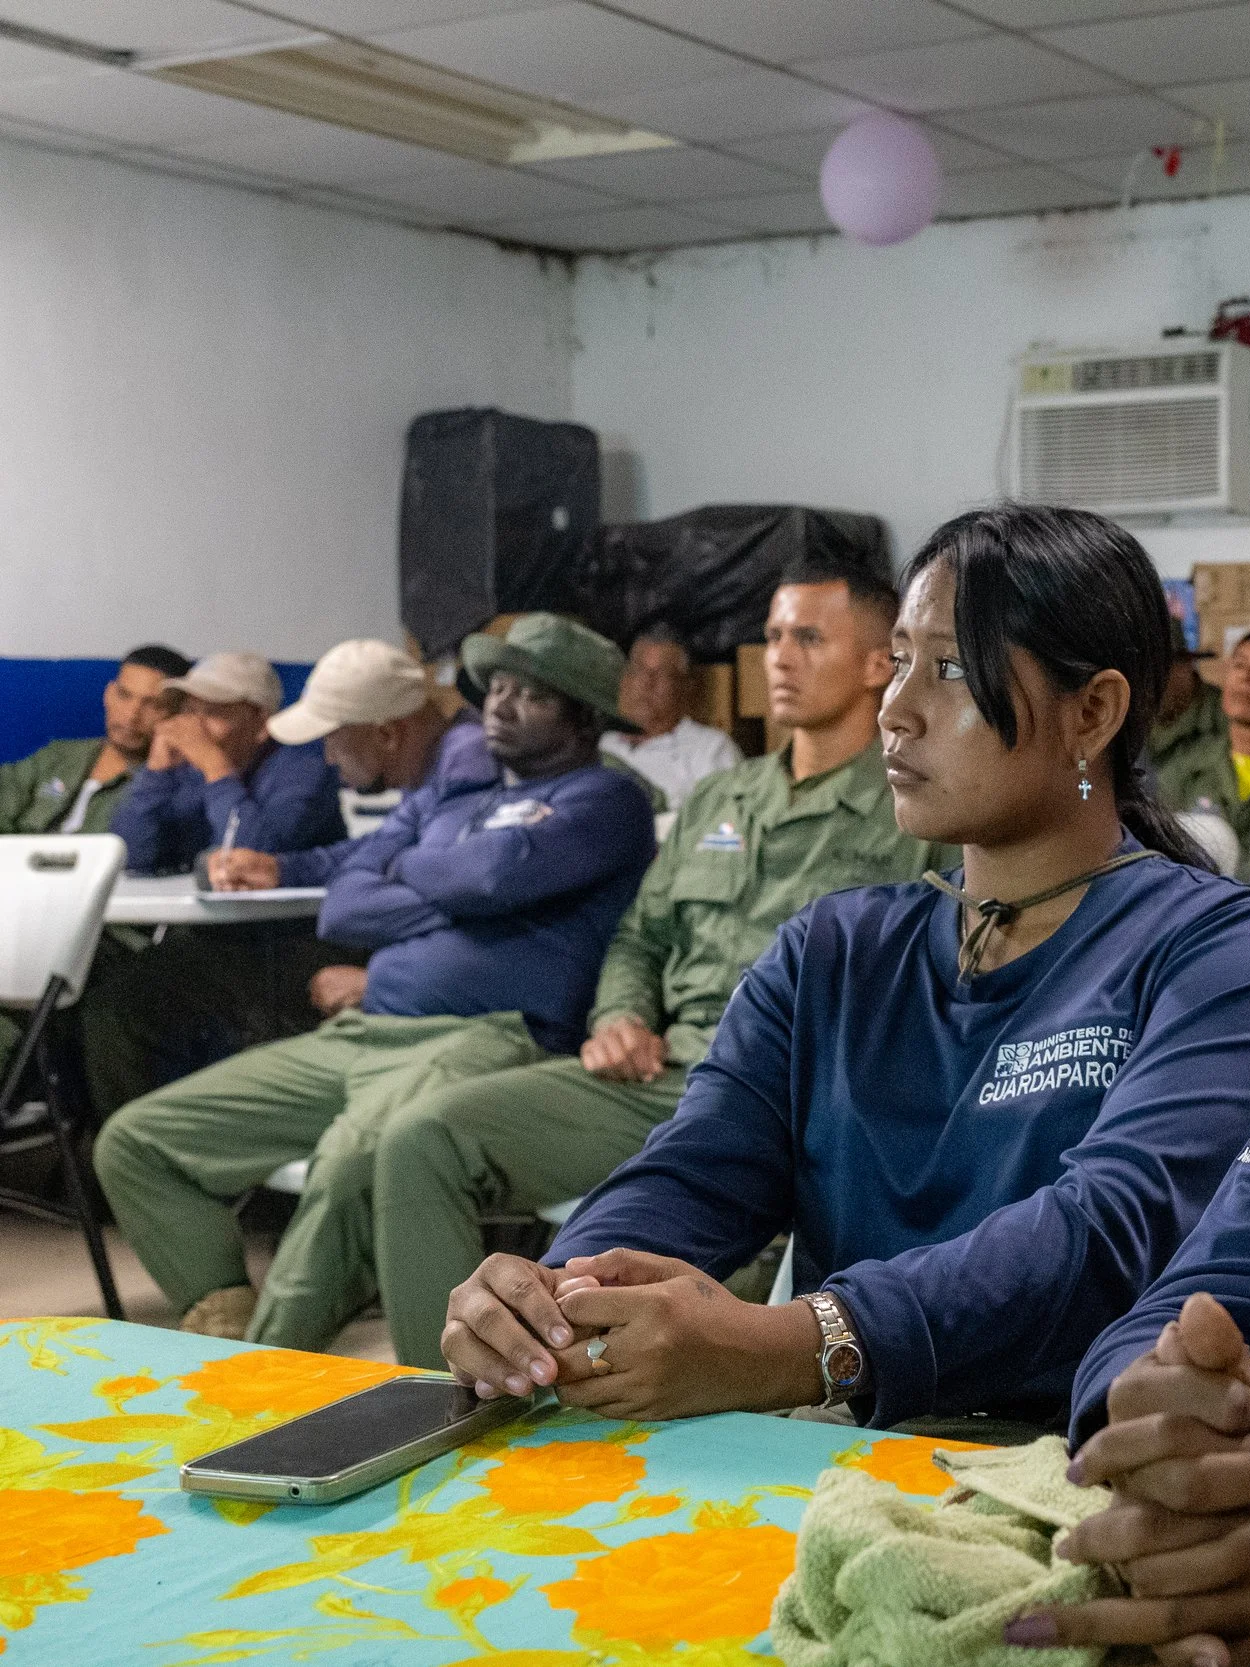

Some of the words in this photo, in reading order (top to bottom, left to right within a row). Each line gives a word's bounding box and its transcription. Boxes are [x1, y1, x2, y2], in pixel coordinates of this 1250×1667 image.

[1027, 1037, 1132, 1070] AMBIENTE
[1032, 1025, 1113, 1053] MINISTERIO
[978, 1061, 1122, 1105] GUARDAPARQ
